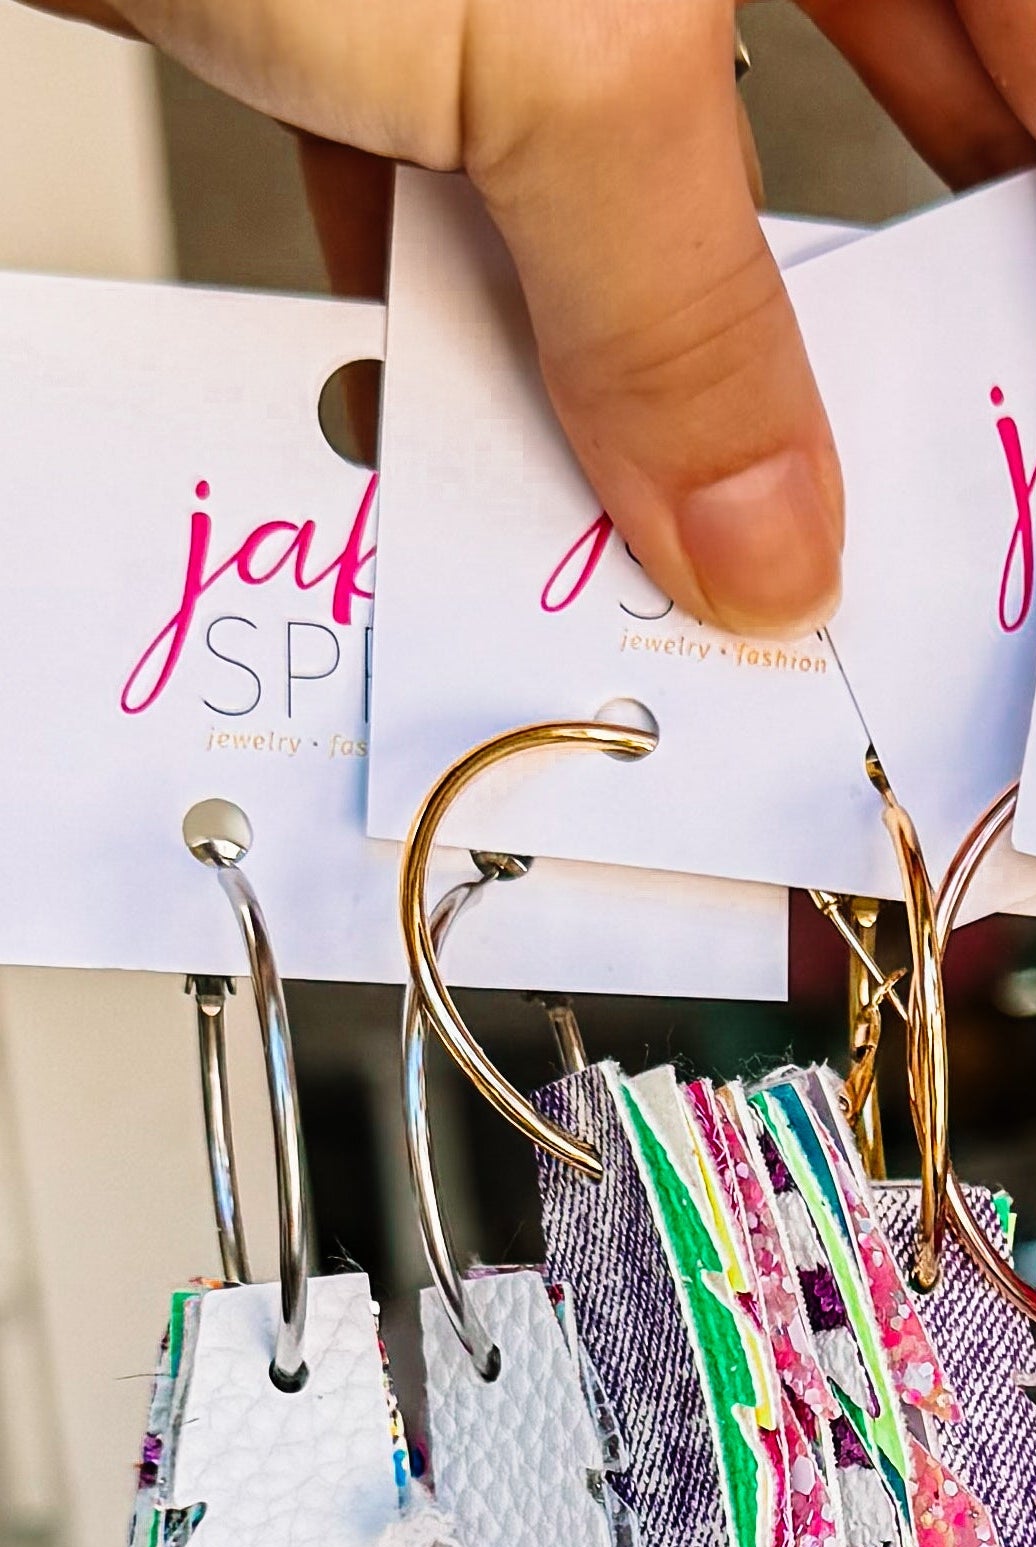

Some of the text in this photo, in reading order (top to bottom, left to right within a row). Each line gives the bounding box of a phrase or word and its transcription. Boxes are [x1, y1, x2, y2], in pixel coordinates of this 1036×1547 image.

[120, 472, 379, 715] jak
[619, 628, 828, 673] jewelry fashion
[206, 726, 301, 757] jewelry
